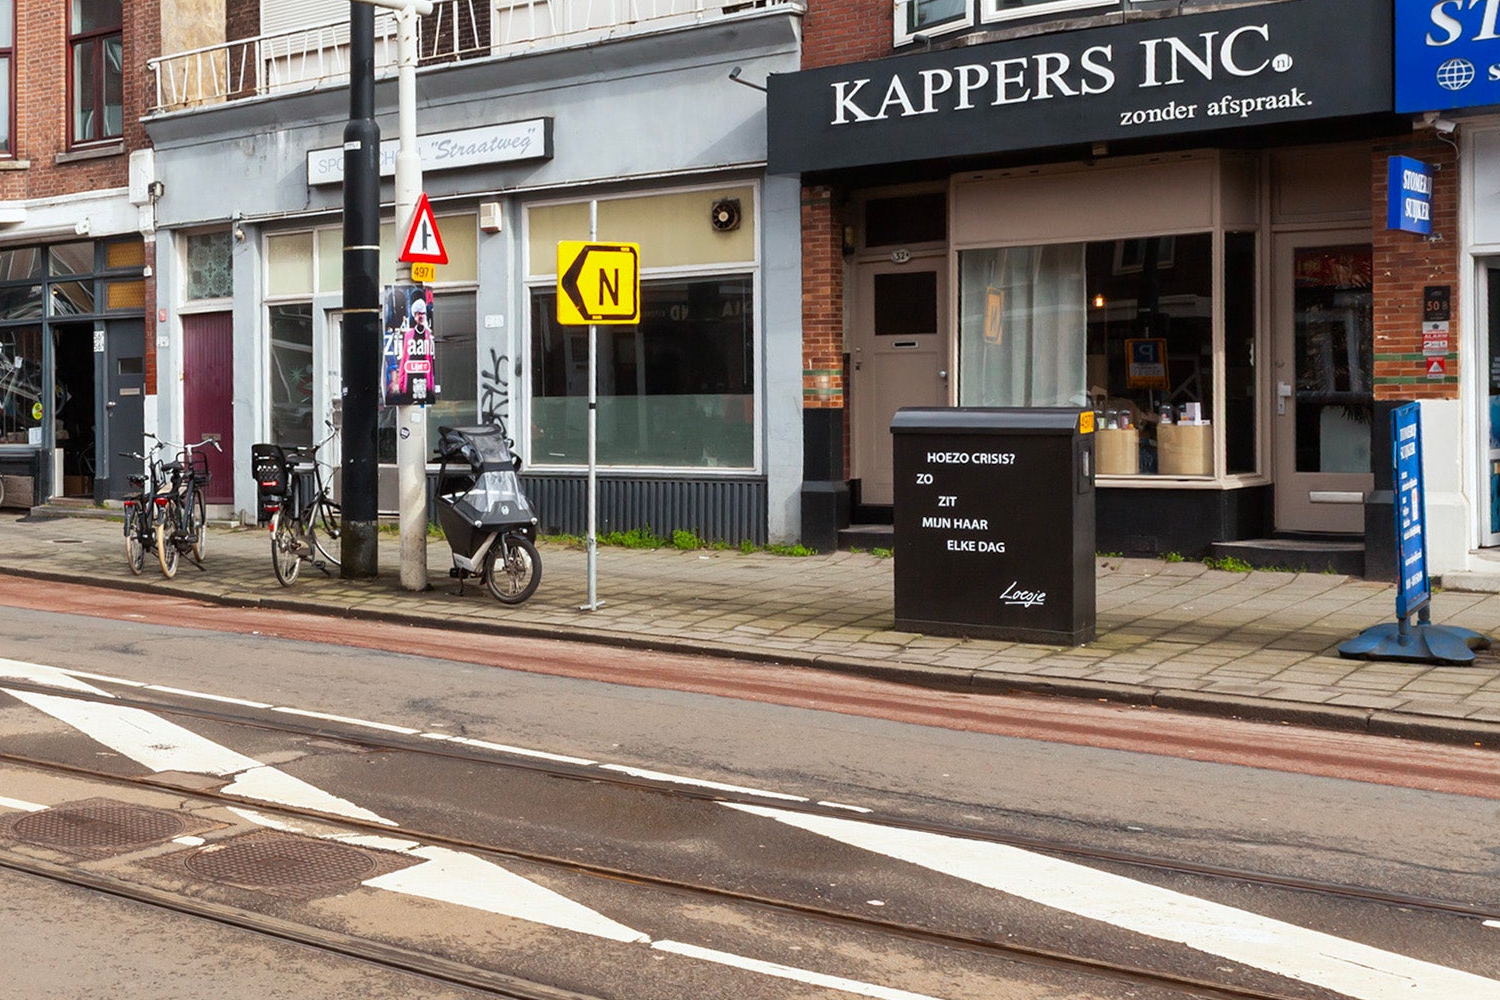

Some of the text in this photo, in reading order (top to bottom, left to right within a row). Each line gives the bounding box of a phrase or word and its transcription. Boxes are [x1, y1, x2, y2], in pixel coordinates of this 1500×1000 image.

[830, 44, 1115, 125] KAPPERS
[1120, 88, 1313, 126] zonder afspraak.
[599, 268, 619, 306] N
[1426, 301, 1440, 312] 50
[384, 333, 404, 360] Zij
[927, 452, 1015, 465] HOEZO CRISIS?
[916, 474, 933, 484] ZO
[938, 496, 957, 507] ZIT
[922, 517, 988, 530] MIJN HAAR
[947, 540, 1006, 553] ELKE DAG
